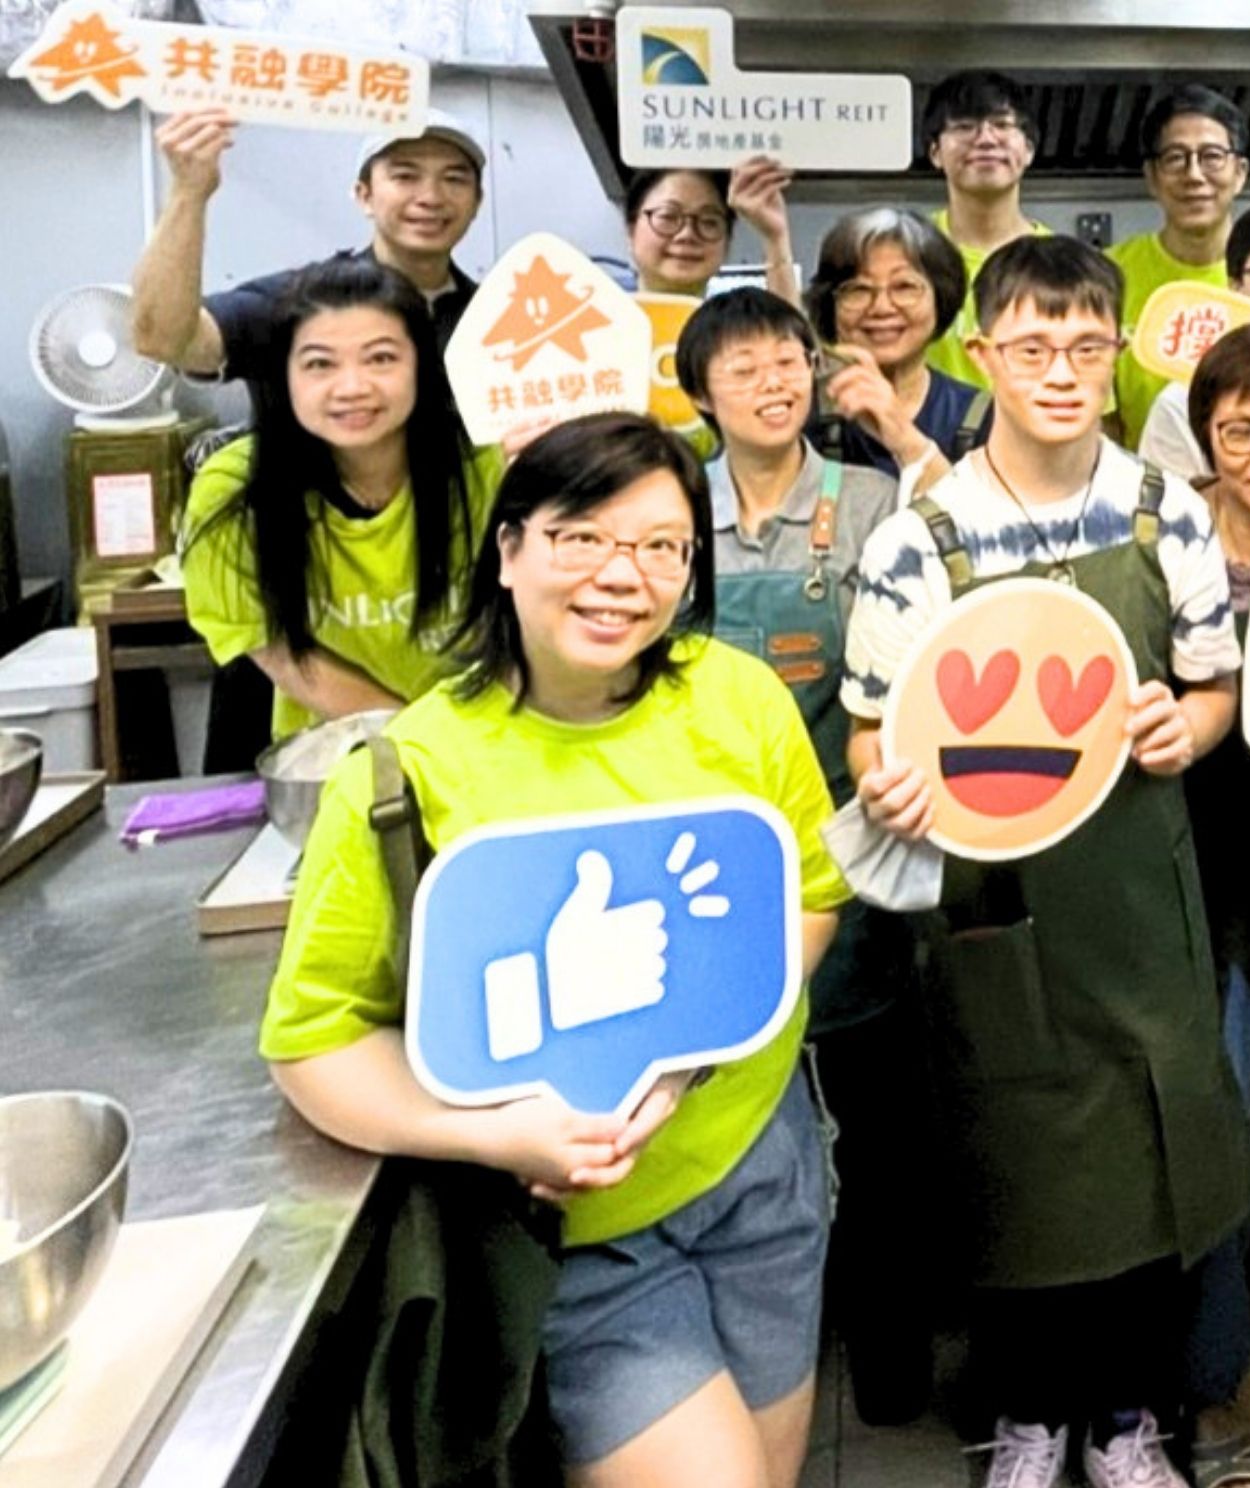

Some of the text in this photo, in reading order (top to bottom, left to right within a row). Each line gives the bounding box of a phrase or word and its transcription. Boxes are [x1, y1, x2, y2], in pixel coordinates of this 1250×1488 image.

[162, 36, 415, 104] 共融學院
[642, 93, 888, 122] SUNLIGHT REIT
[487, 367, 625, 412] 共融學院
